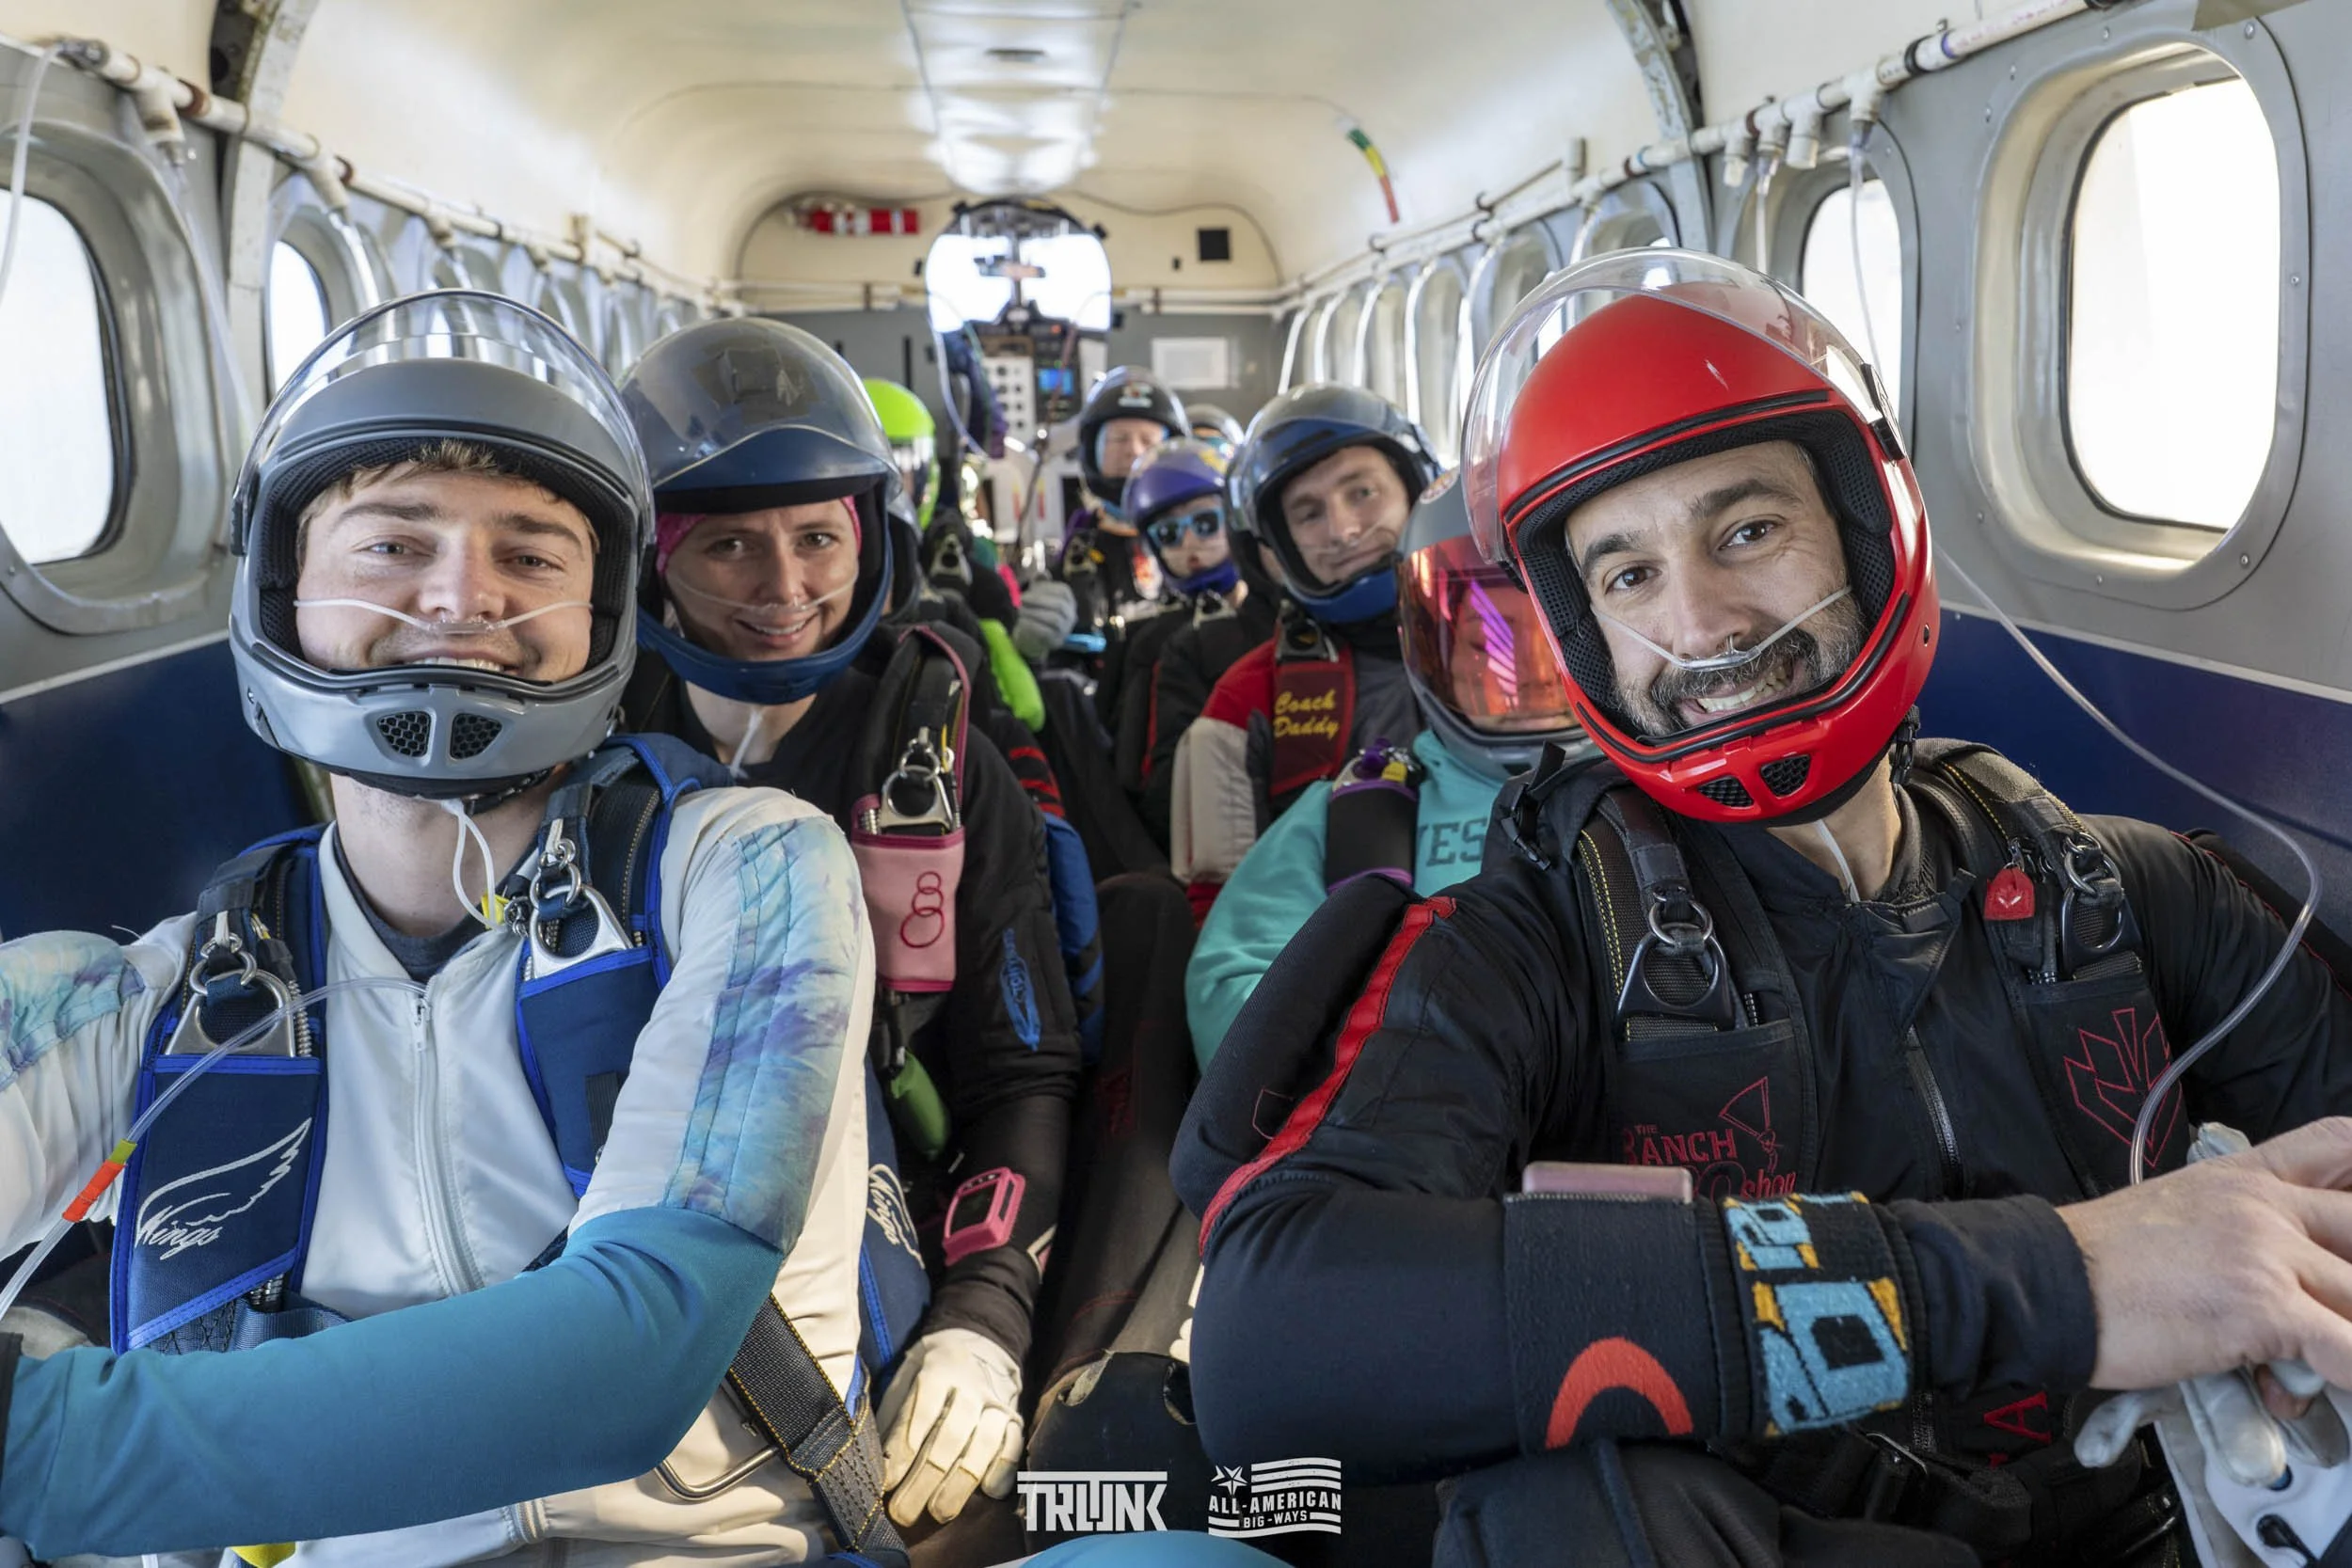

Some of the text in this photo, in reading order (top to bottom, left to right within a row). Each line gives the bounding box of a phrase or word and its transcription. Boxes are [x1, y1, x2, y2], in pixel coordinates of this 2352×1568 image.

[1275, 689, 1335, 715] Coach
[1273, 716, 1340, 741] Daddy
[1634, 1124, 1658, 1135] THE
[135, 1205, 223, 1260] Wings
